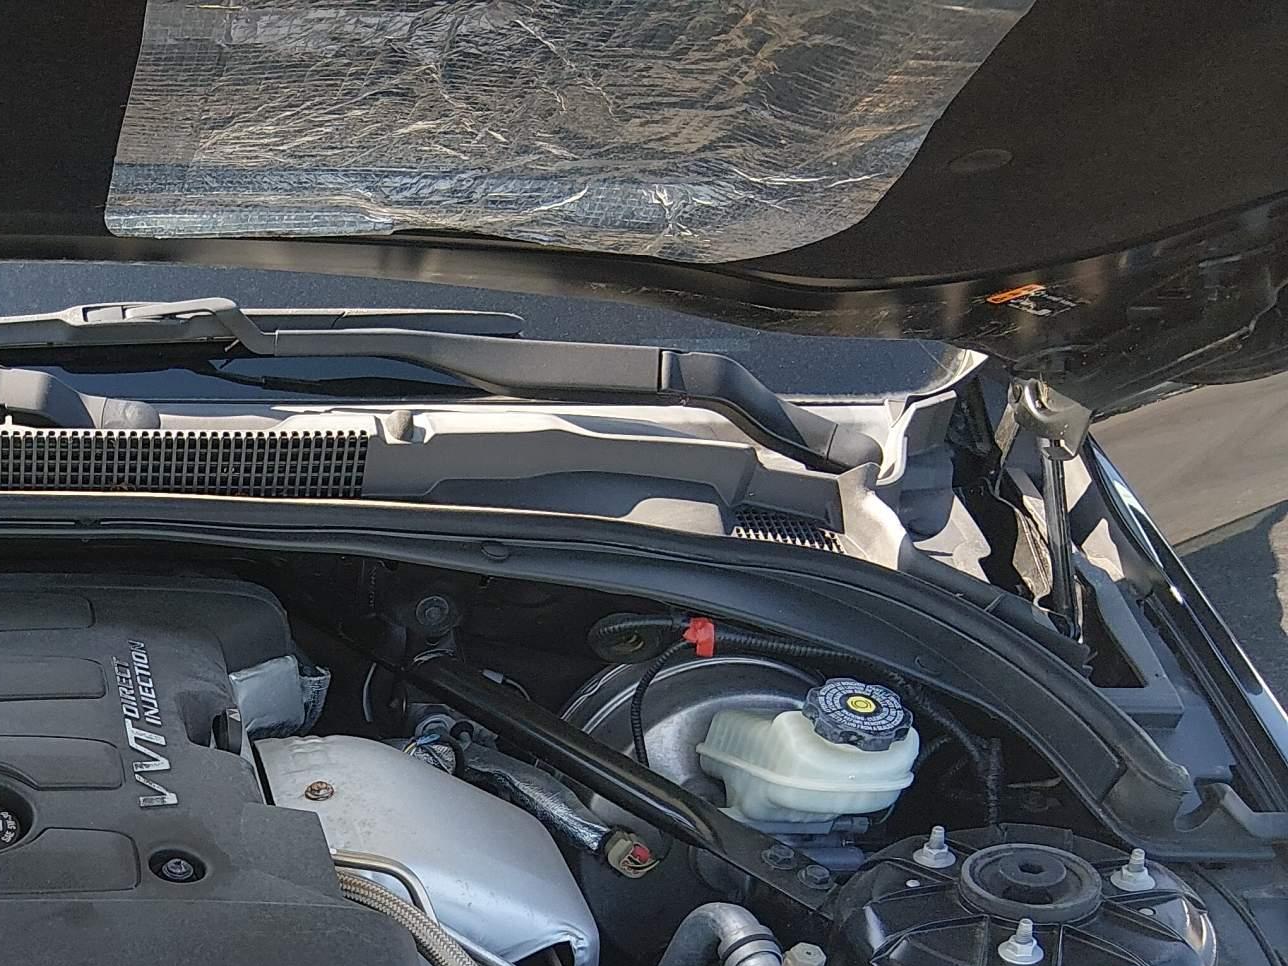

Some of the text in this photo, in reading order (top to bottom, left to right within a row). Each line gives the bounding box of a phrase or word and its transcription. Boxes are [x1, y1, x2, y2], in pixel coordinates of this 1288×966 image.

[113, 656, 140, 719] DIRECT
[128, 640, 162, 726] INJECTION
[124, 718, 178, 807] VVT
